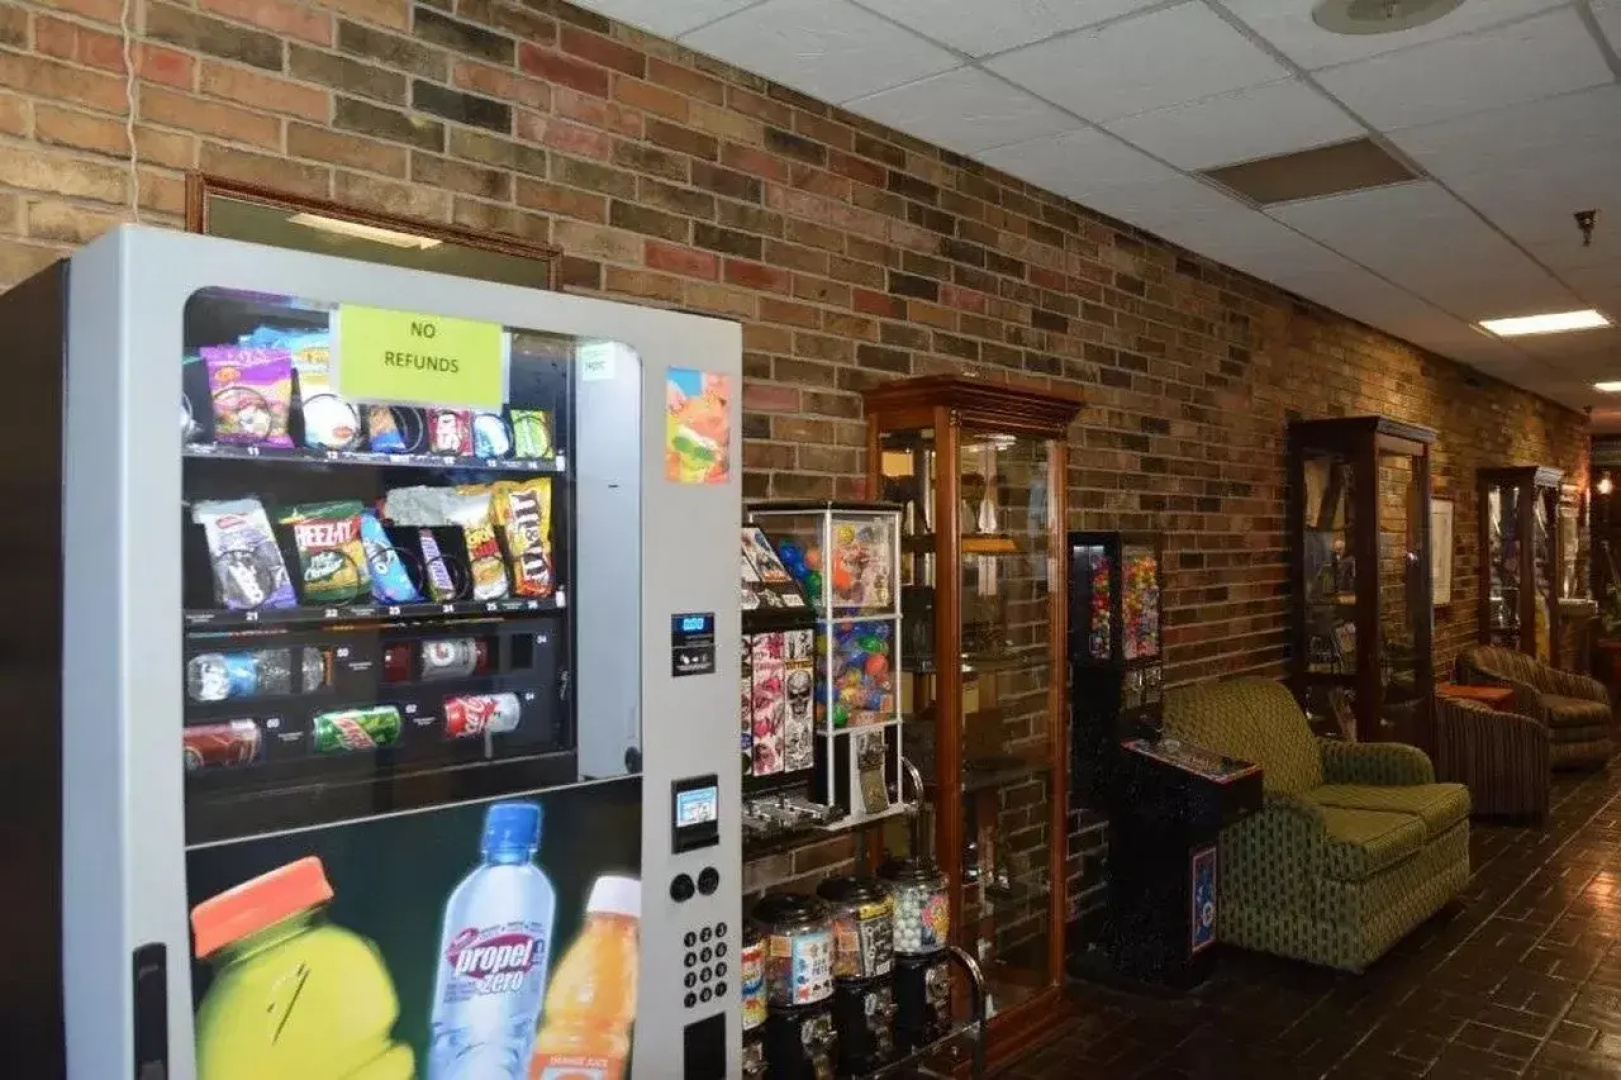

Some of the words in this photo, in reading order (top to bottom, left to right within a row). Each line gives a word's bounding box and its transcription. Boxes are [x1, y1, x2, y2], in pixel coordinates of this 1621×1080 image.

[410, 321, 436, 339] NO
[384, 351, 459, 373] REFUNDS
[455, 938, 533, 976] propel
[476, 969, 525, 995] zero
